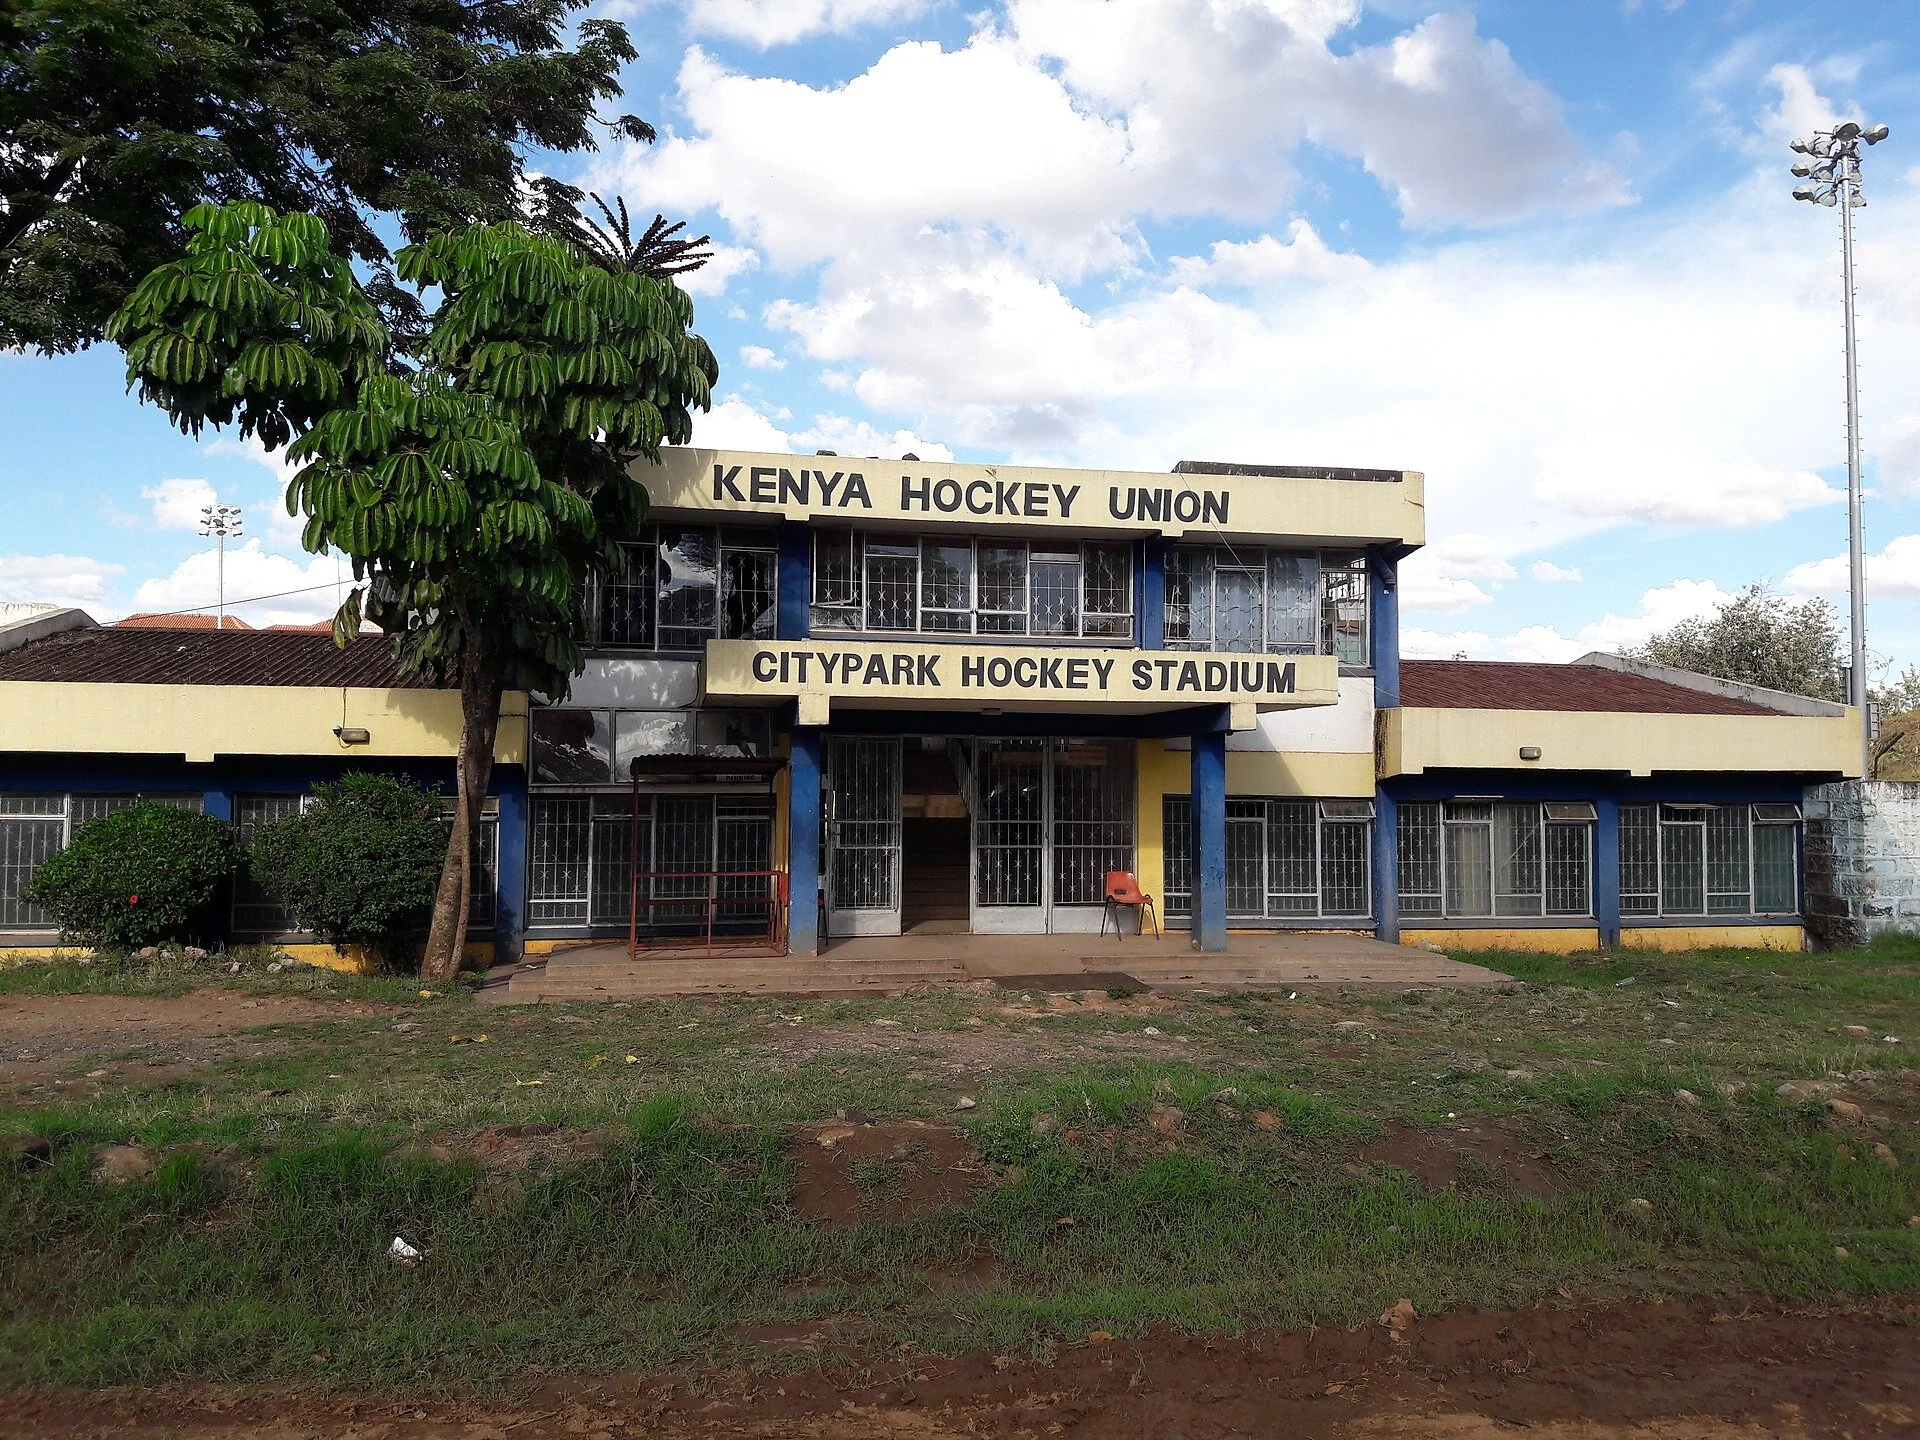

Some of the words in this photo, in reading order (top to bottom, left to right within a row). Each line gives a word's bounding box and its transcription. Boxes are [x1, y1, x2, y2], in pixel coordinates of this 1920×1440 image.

[713, 464, 873, 509] KENYA
[900, 475, 1082, 518] HOCKEY
[1108, 486, 1230, 525] UNION
[752, 650, 942, 687] CITYPARK
[961, 655, 1115, 690] HOCKEY
[1131, 659, 1296, 694] STADIUM
